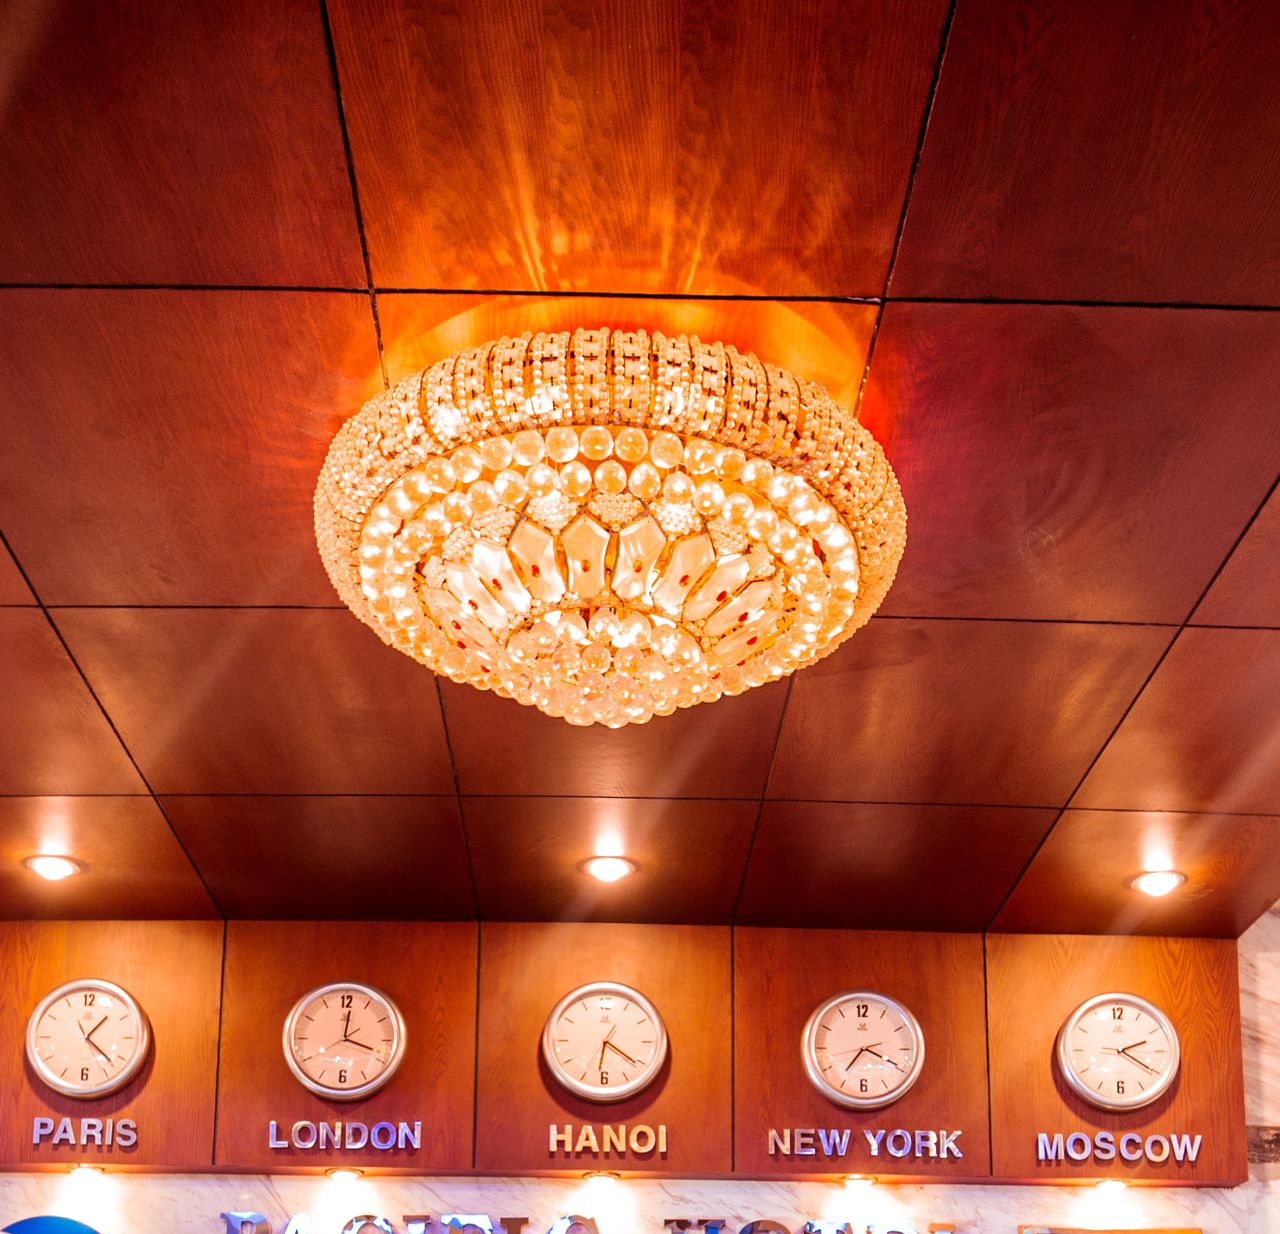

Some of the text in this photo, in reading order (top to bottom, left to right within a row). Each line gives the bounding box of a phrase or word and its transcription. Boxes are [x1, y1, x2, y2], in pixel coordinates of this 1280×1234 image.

[83, 994, 96, 1007] 12
[341, 995, 353, 1008] 12
[856, 1004, 869, 1018] 12
[1112, 1007, 1124, 1020] 12
[80, 1067, 89, 1081] 6
[338, 1070, 347, 1083] 6
[600, 1071, 609, 1085] 6
[859, 1079, 868, 1092] 6
[1116, 1081, 1125, 1094] 6
[32, 1117, 138, 1147] PARIS
[269, 1120, 421, 1150] LONDON
[549, 1124, 667, 1153] HANOI
[768, 1128, 963, 1159] NEW YORK
[1037, 1131, 1202, 1162] MOSCOW
